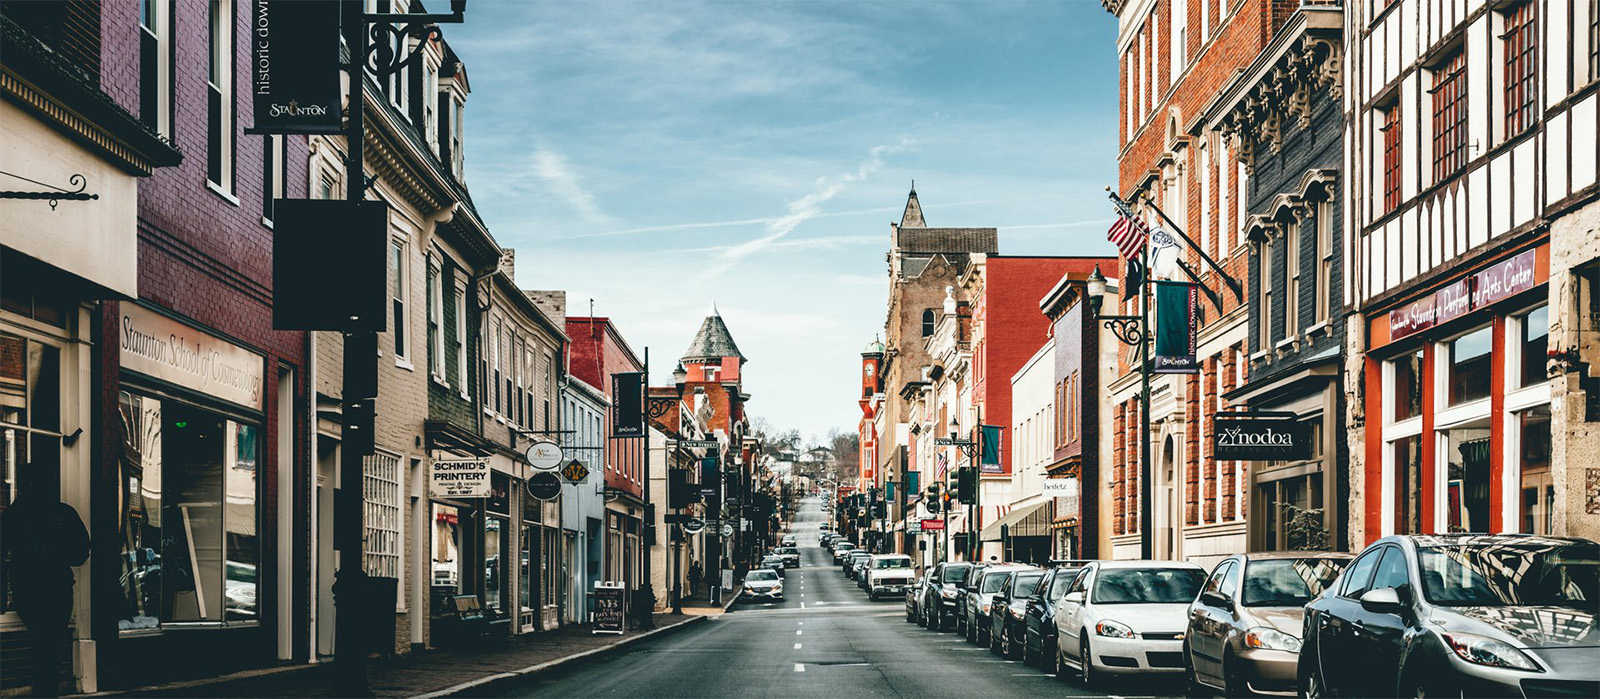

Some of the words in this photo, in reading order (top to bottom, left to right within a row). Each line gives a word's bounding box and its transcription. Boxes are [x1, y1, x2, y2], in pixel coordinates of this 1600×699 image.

[256, 40, 270, 95] historic
[269, 102, 326, 117] STAUNTON
[1189, 289, 1197, 328] downtown
[1411, 303, 1441, 329] Staunton
[1482, 272, 1501, 302] Arts
[1504, 262, 1531, 292] Center
[122, 315, 167, 362] Staunton
[169, 333, 199, 374] School
[201, 348, 212, 386] of
[212, 351, 262, 402] Cosmetology
[434, 462, 486, 470] SCHMID'S
[434, 472, 486, 480] PRINTERY
[1043, 482, 1067, 490] heifetz
